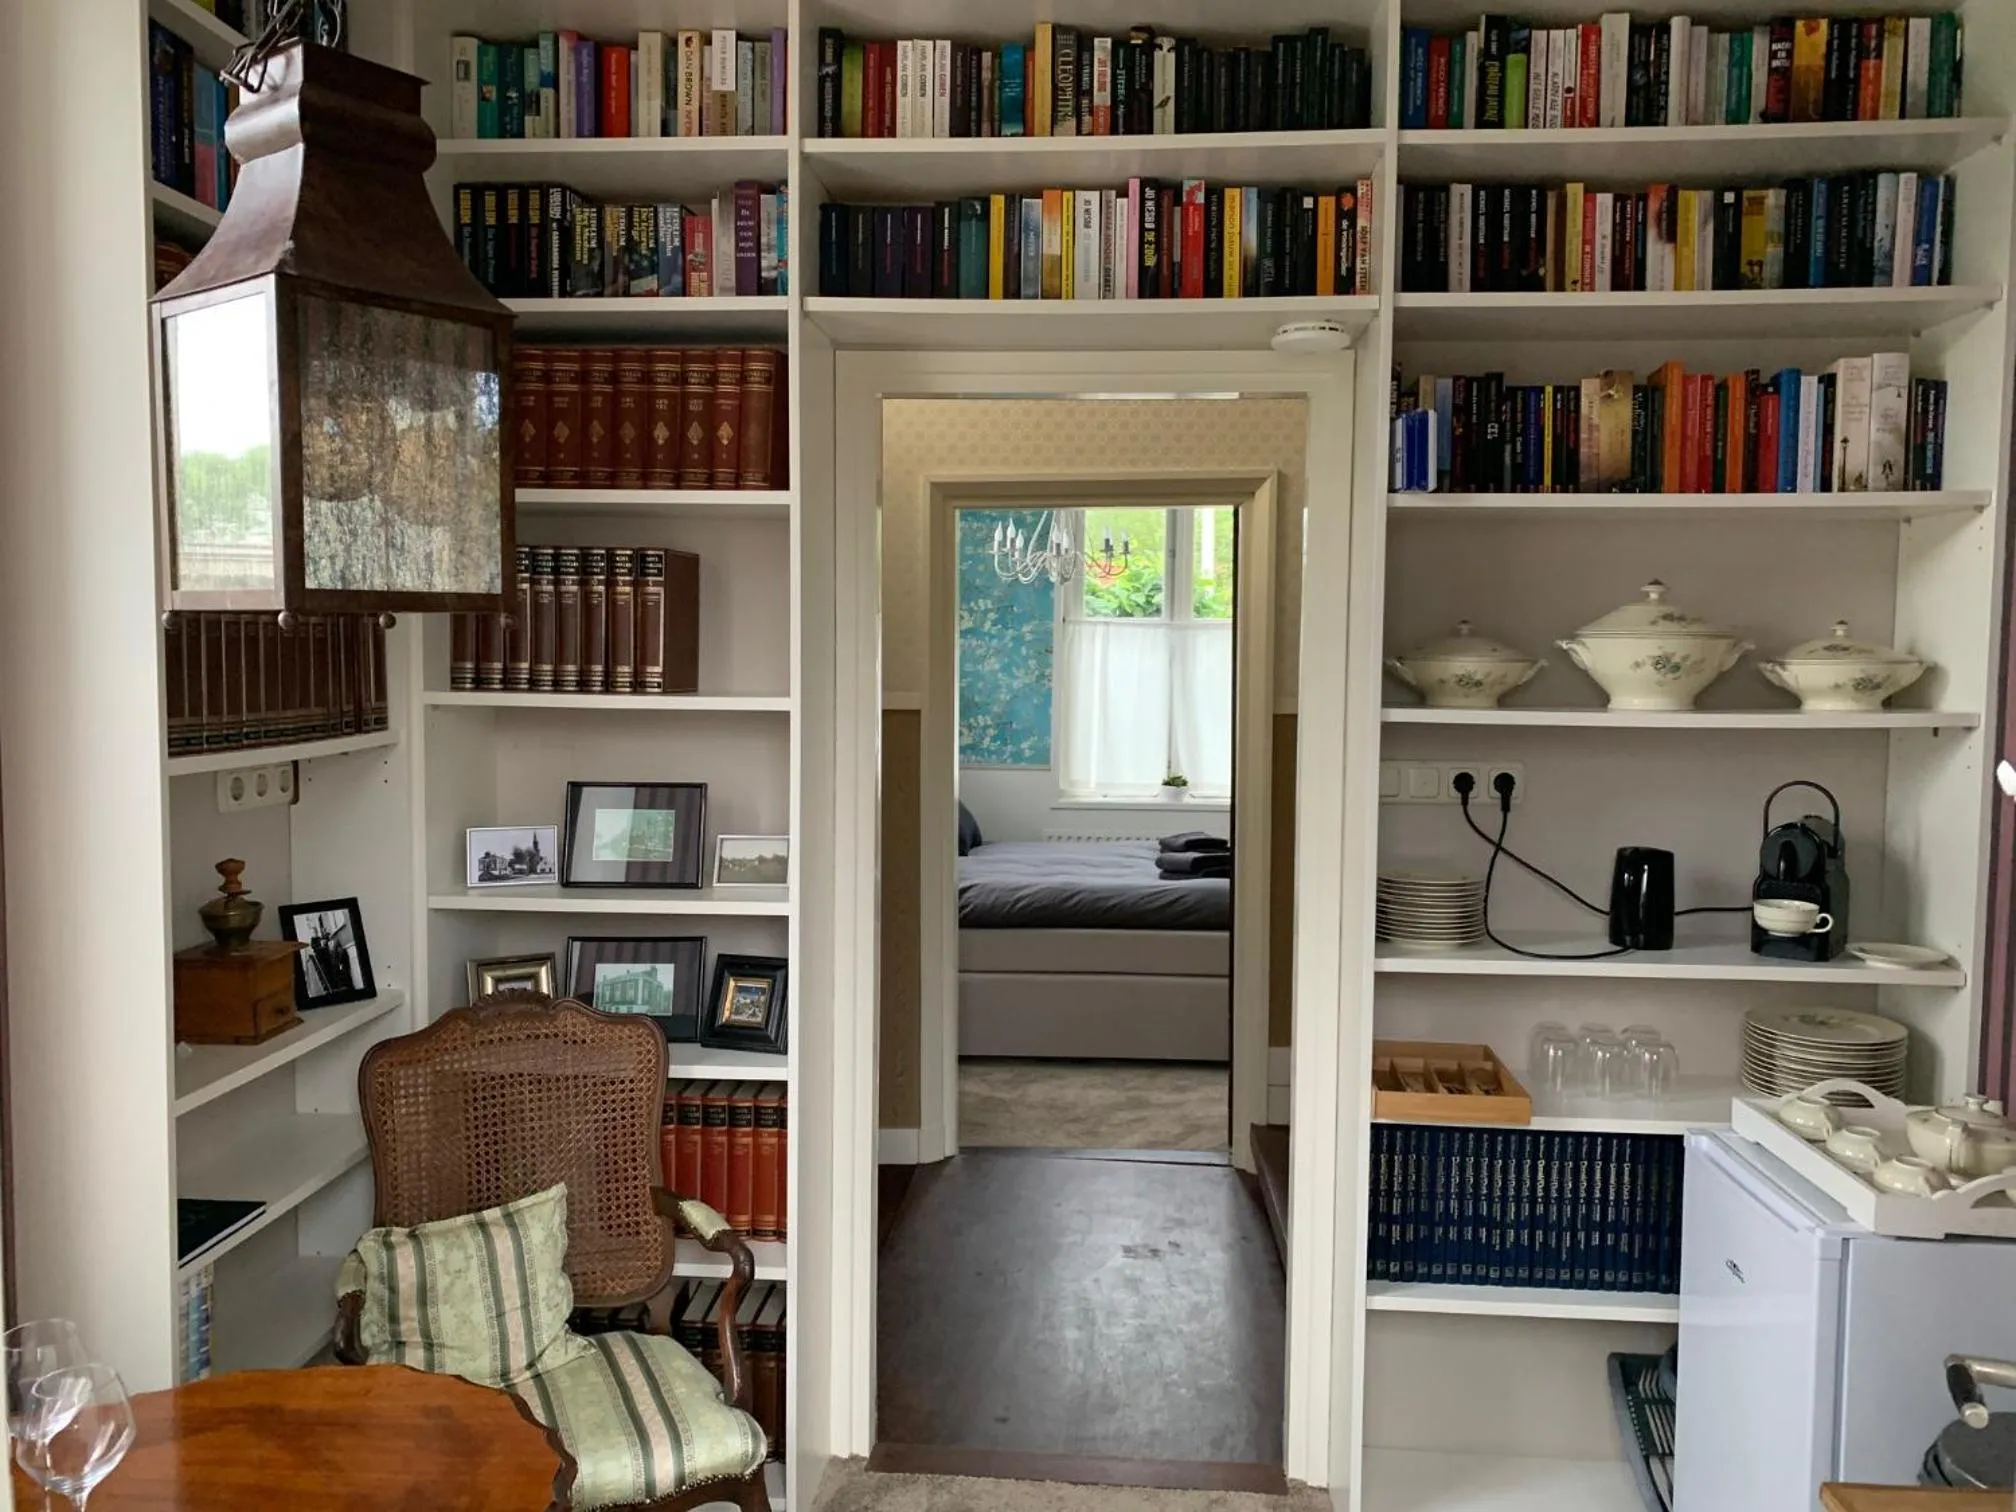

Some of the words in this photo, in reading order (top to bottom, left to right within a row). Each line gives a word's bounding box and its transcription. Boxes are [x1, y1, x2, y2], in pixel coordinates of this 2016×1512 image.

[684, 51, 694, 70] DAN
[684, 72, 694, 106] BROWN
[1144, 187, 1156, 199] JO
[1144, 200, 1156, 229] NESBØ
[1144, 231, 1156, 243] DE
[1144, 244, 1156, 266] ZOON
